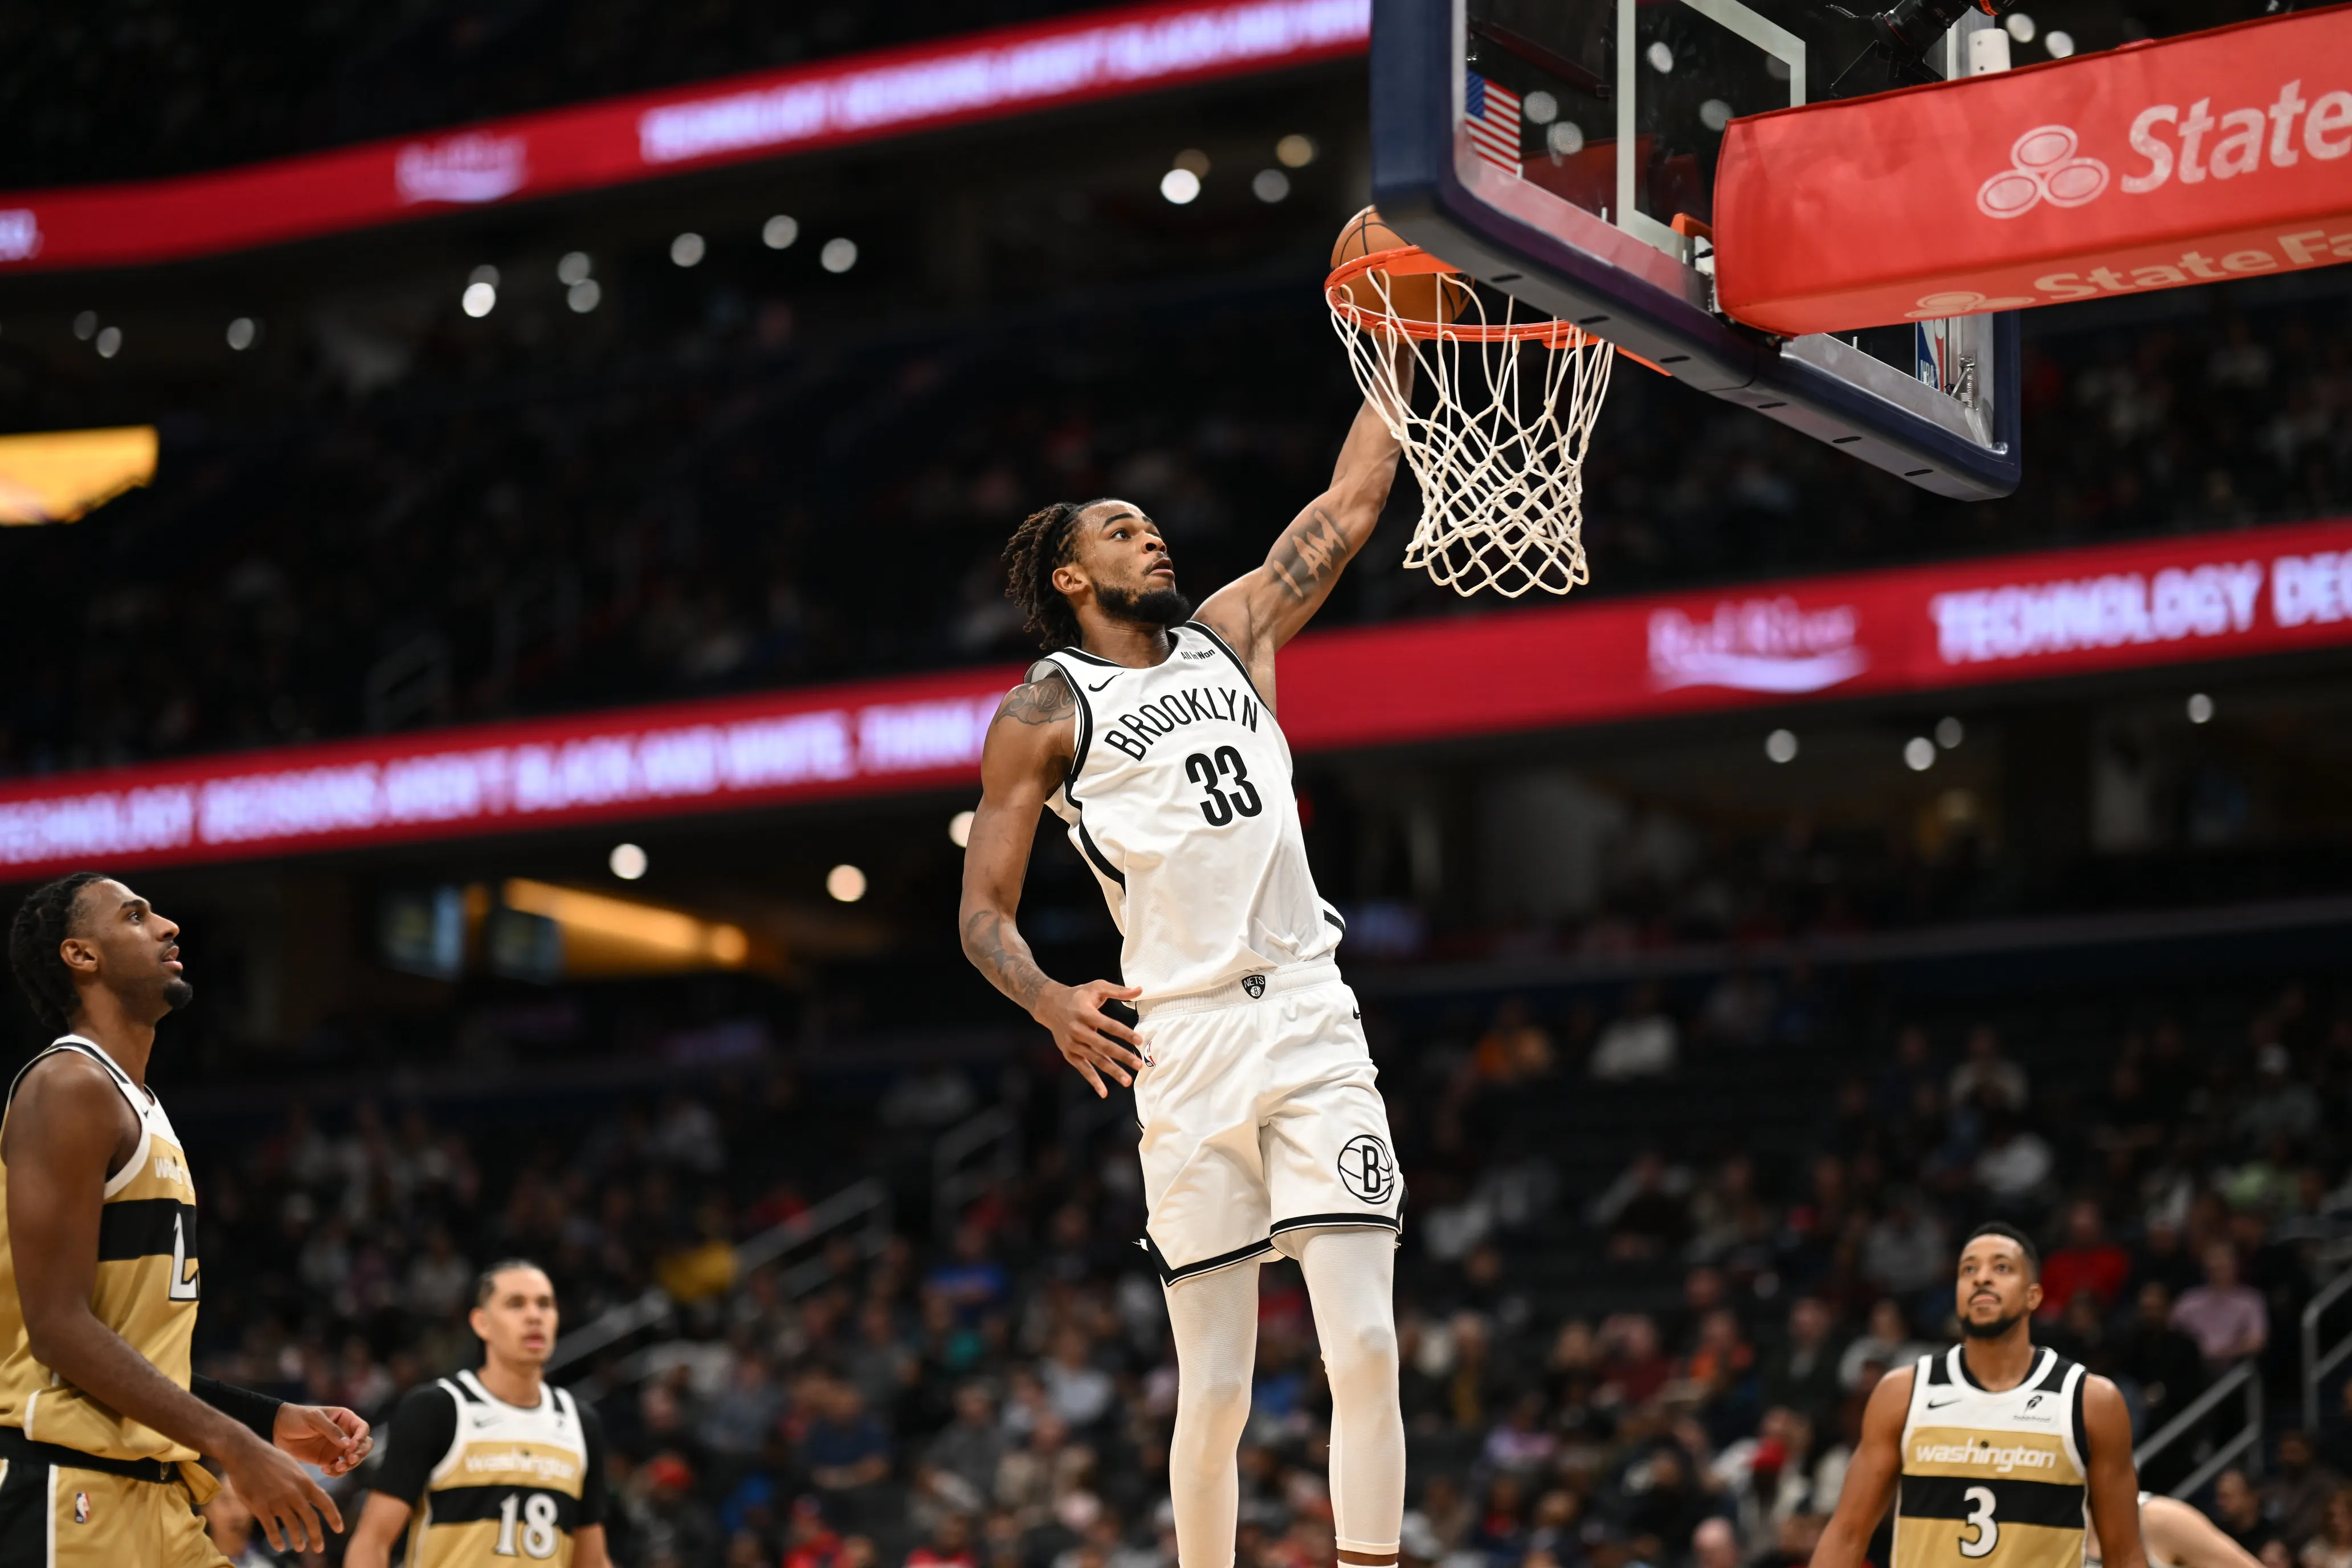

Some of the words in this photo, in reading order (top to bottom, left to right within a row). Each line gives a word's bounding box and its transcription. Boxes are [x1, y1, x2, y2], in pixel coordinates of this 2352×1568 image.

[2120, 79, 2352, 194] State
[2034, 251, 2278, 300] State
[1932, 558, 2267, 665] TECHNOLOGY
[1181, 651, 1192, 660] All
[1198, 649, 1216, 660] Won
[1104, 687, 1257, 762] BROOKLYN
[1185, 745, 1263, 827] 33
[1243, 976, 1264, 989] NETS
[1253, 987, 1259, 996] B
[1362, 1145, 1381, 1193] B
[1916, 1438, 2056, 1472] washington
[493, 1492, 559, 1559] 18
[1958, 1485, 2000, 1558] 3
